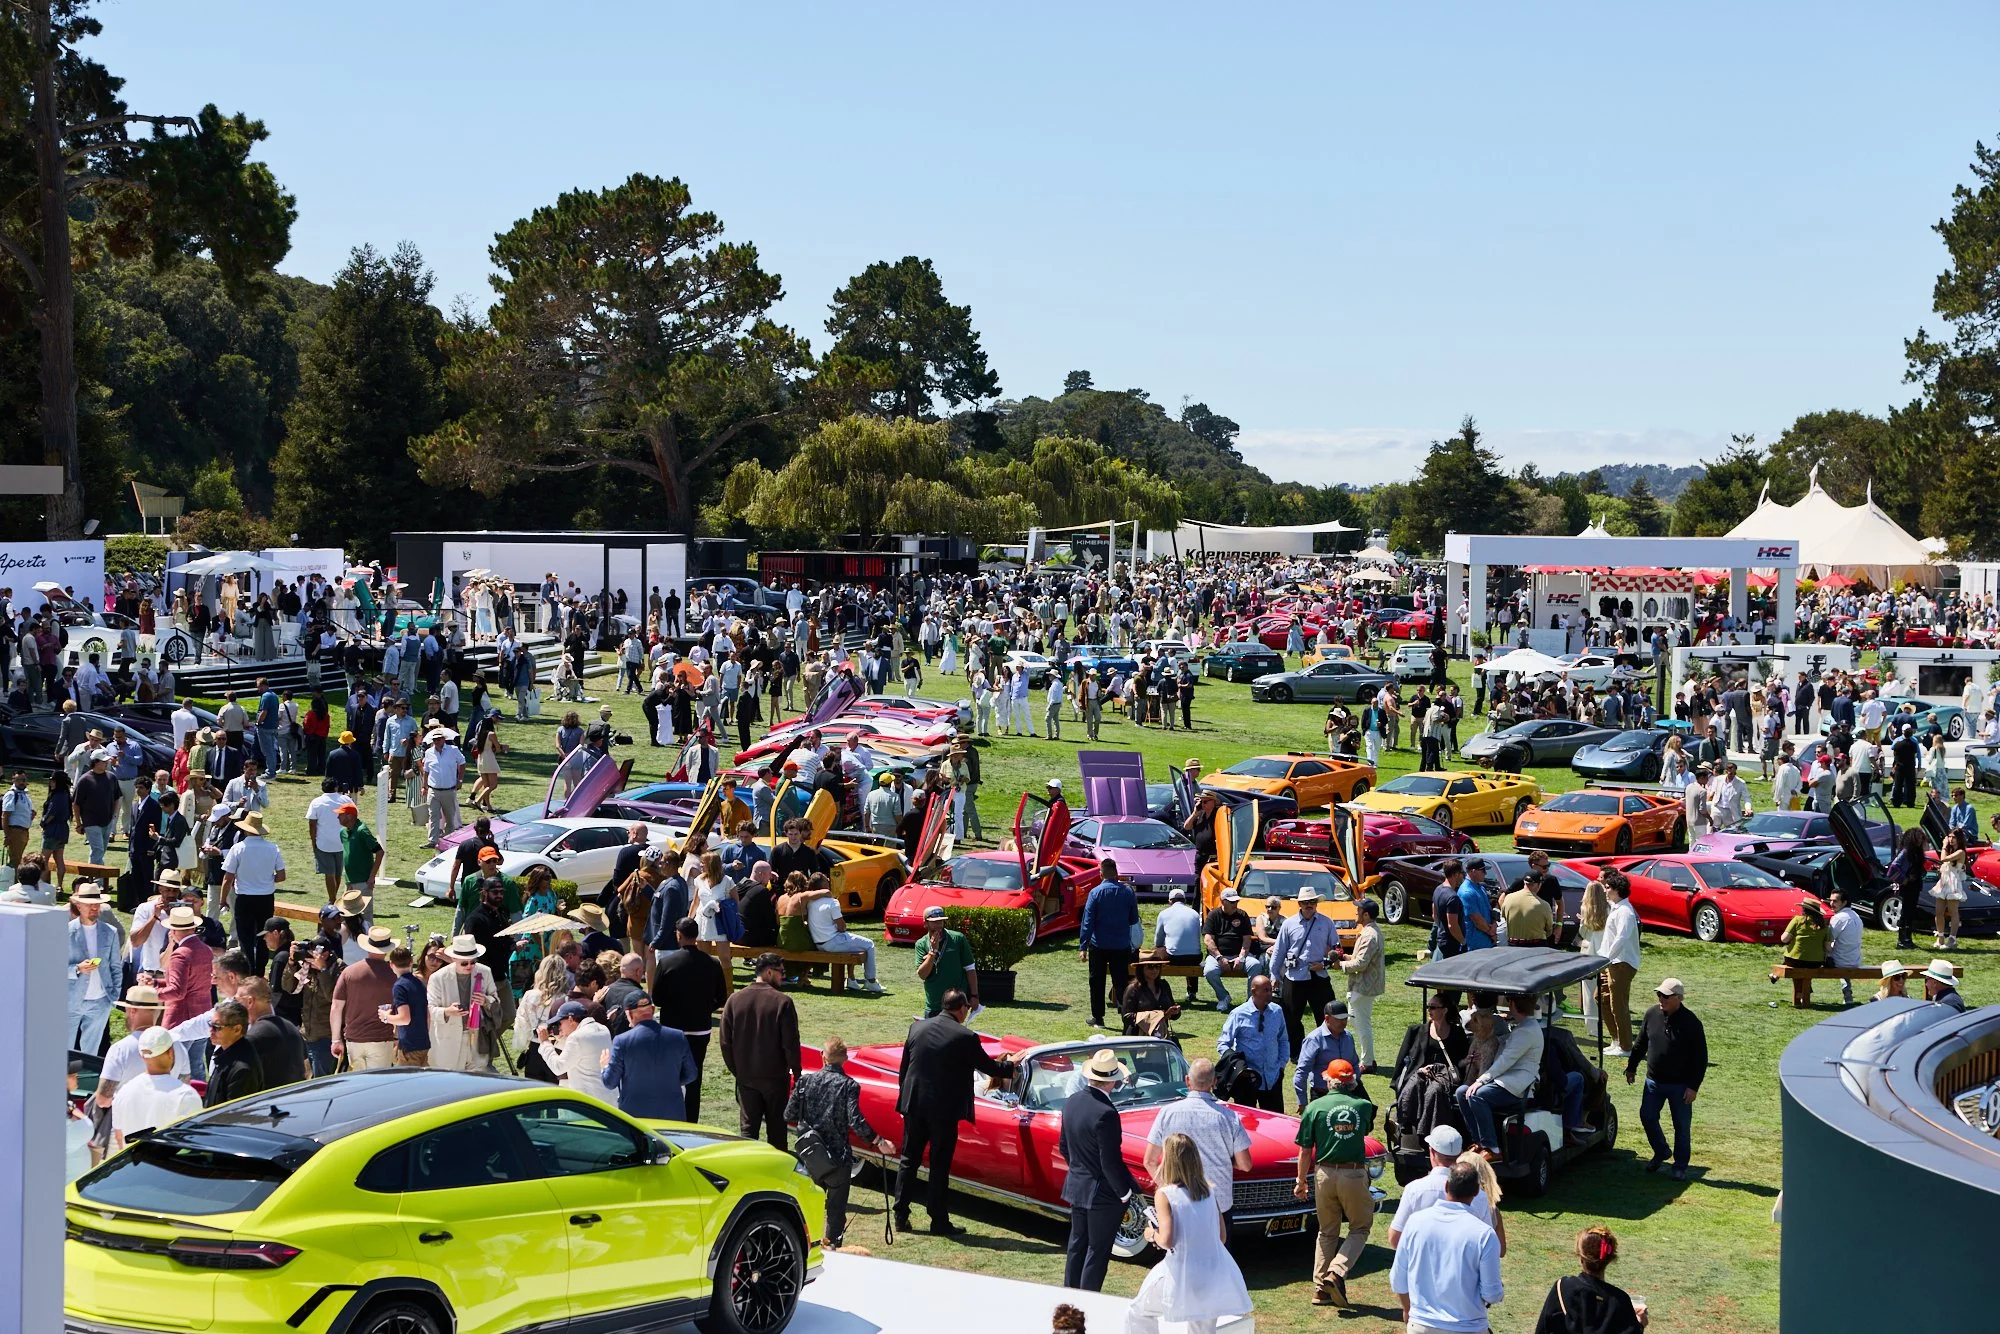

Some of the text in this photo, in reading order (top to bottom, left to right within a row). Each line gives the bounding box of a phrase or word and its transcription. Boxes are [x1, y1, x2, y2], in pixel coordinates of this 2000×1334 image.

[1757, 546, 1792, 557] HRC
[0, 553, 46, 575] Aperta
[1546, 593, 1581, 603] HRC
